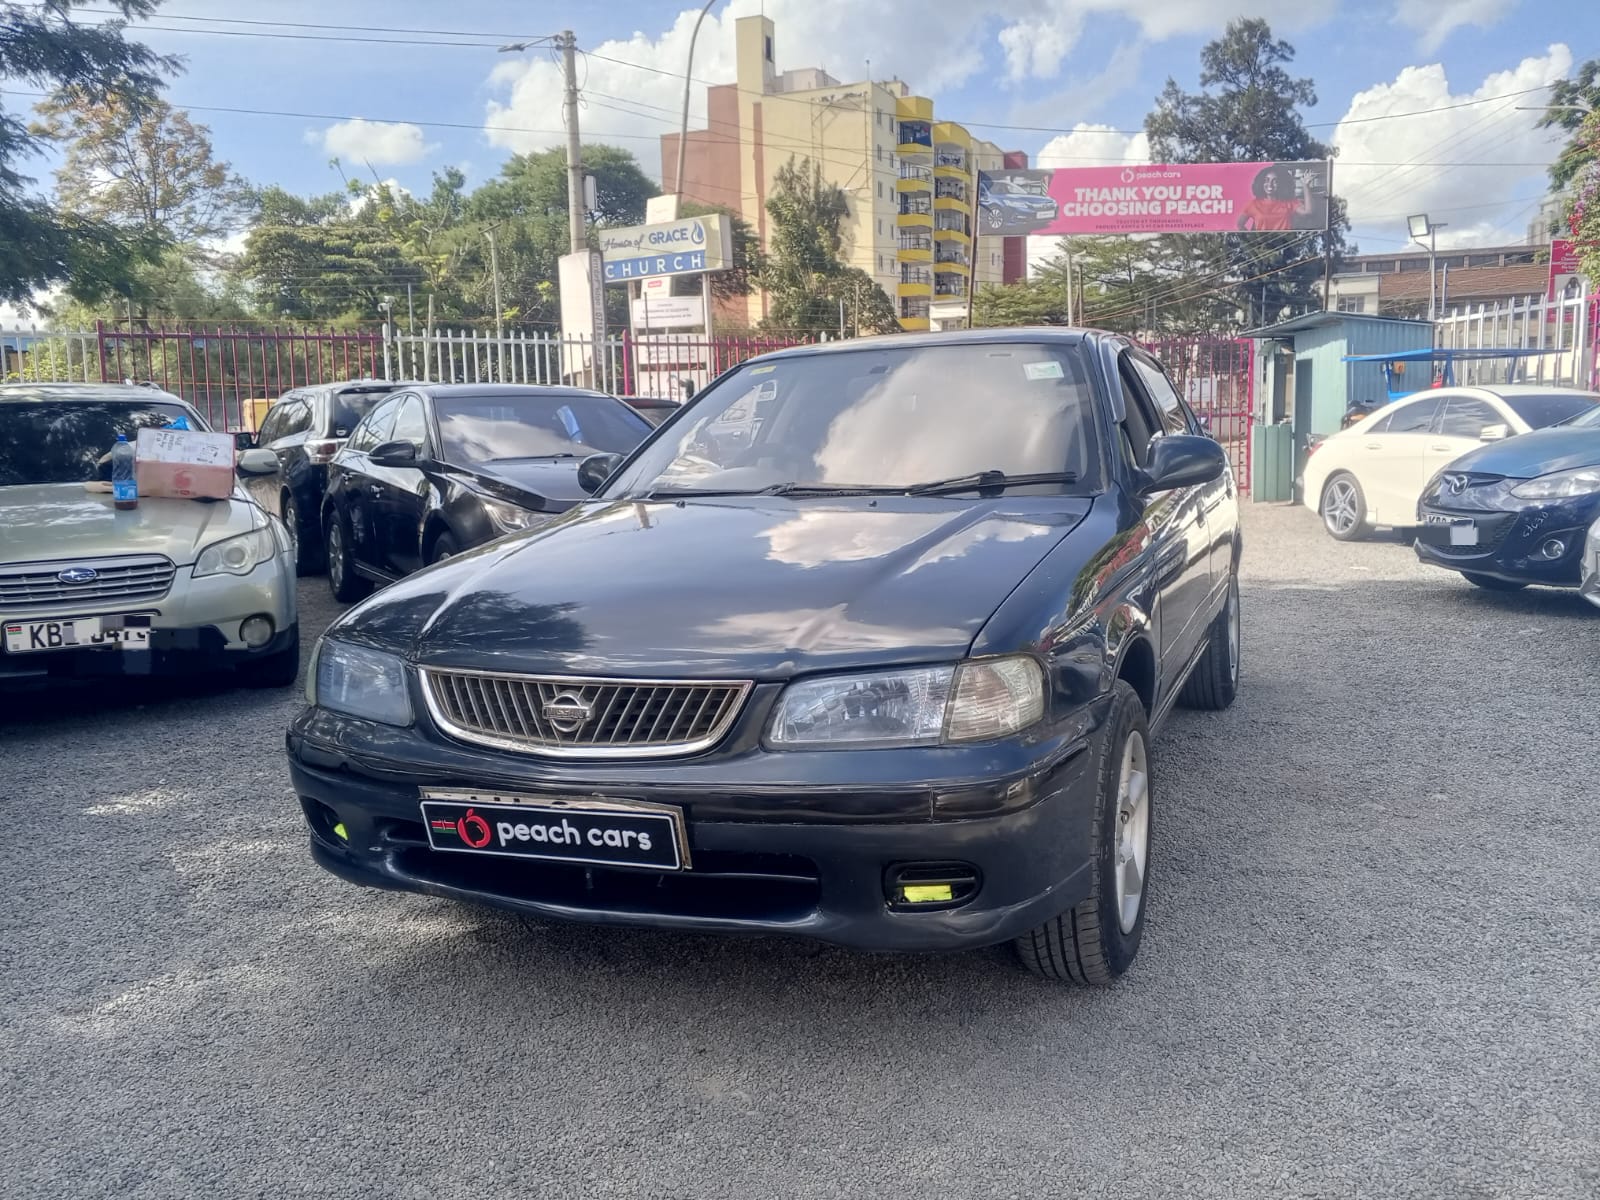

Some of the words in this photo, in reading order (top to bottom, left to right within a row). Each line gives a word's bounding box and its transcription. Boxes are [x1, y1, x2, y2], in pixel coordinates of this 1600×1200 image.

[1136, 170, 1162, 181] peach
[1163, 171, 1181, 179] cars
[1074, 186, 1139, 202] THANK
[1141, 185, 1182, 201] YOU
[1185, 184, 1223, 200] FOR
[1063, 201, 1162, 217] CHOOSING
[1165, 199, 1234, 215] PEACH!
[604, 238, 633, 252] House
[634, 234, 645, 252] of
[648, 228, 689, 245] GRACE
[605, 253, 702, 278] CHURCH
[496, 818, 581, 848] peach
[587, 826, 652, 851] cars
